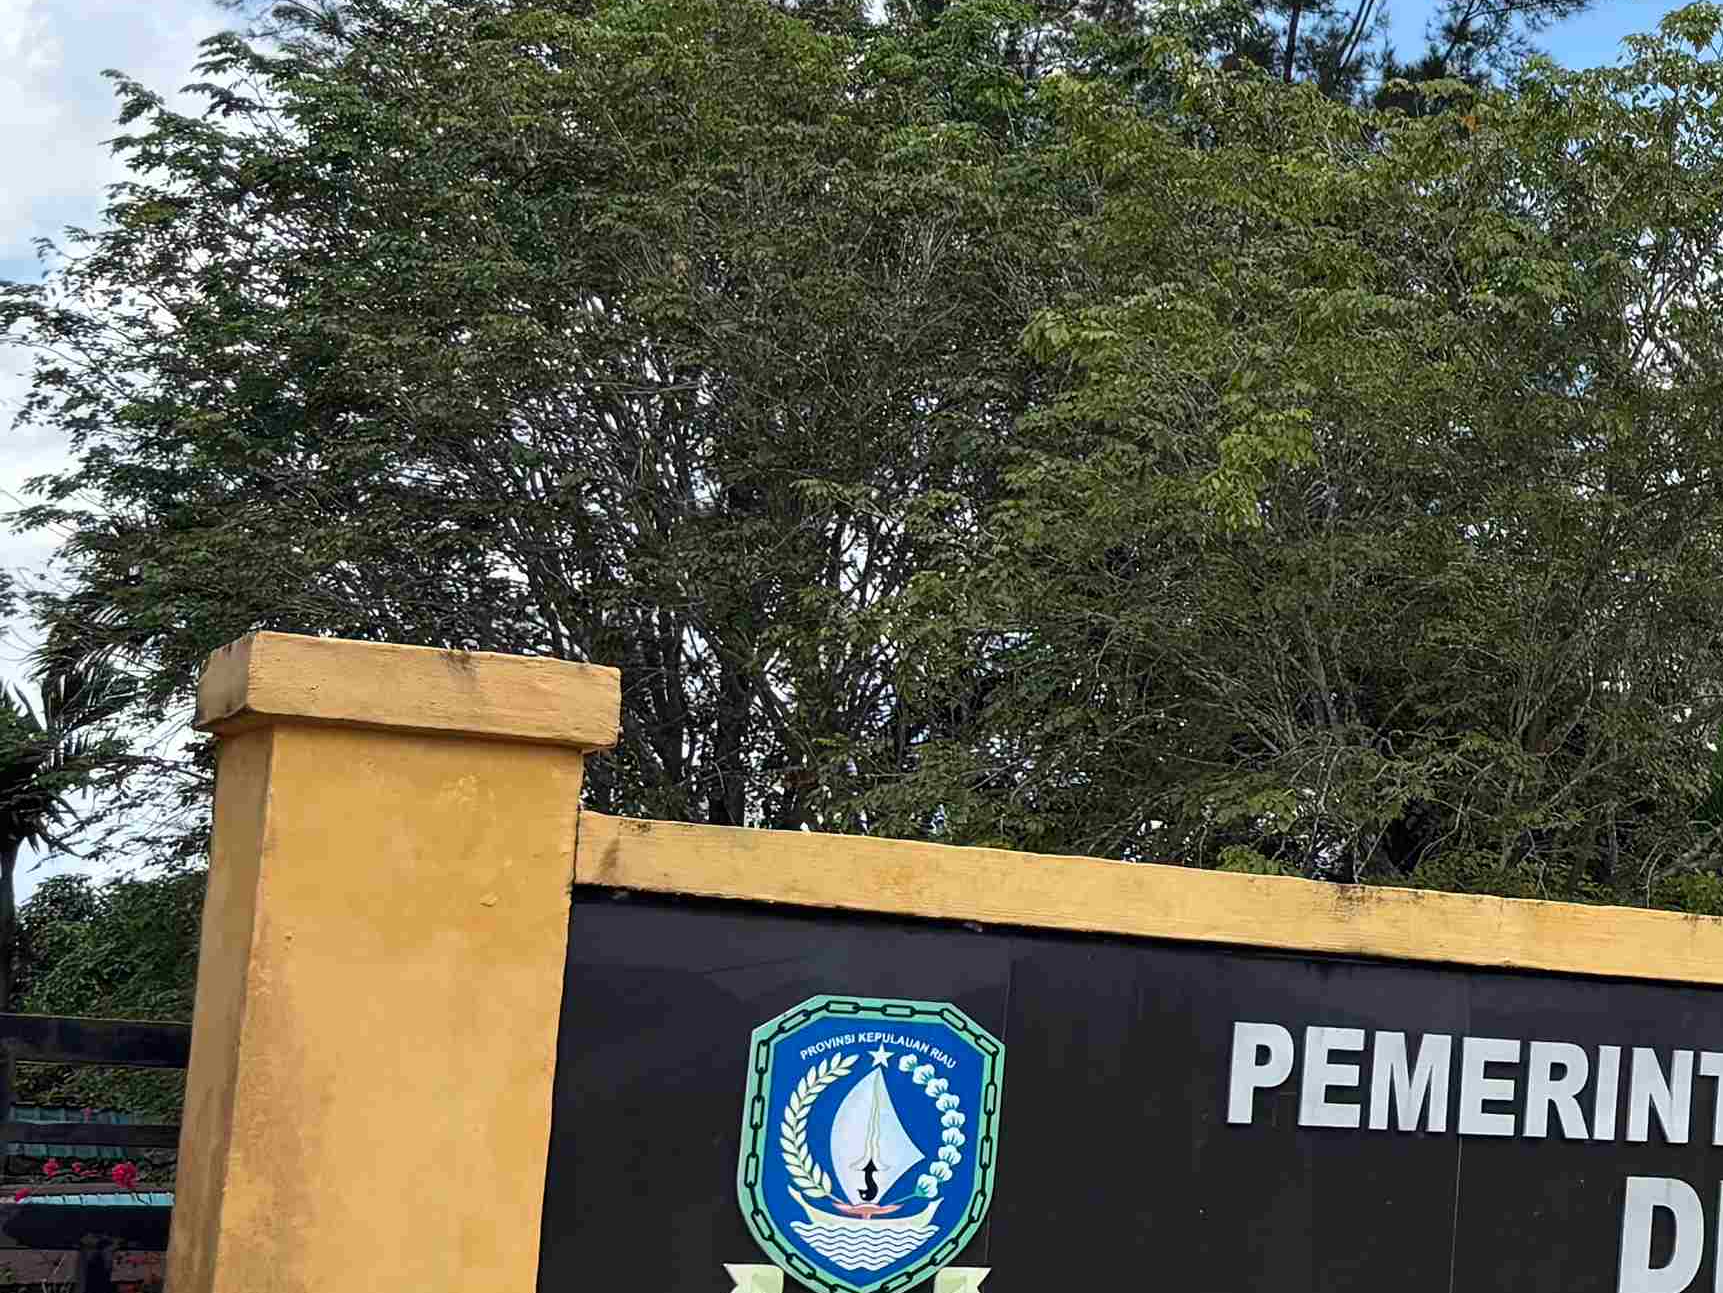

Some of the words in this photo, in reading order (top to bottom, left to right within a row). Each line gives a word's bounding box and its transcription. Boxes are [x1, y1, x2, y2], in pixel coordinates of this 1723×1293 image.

[800, 1033, 856, 1061] PROVINSI
[858, 1032, 929, 1054] KEPULAUAN
[929, 1045, 957, 1070] RIAU
